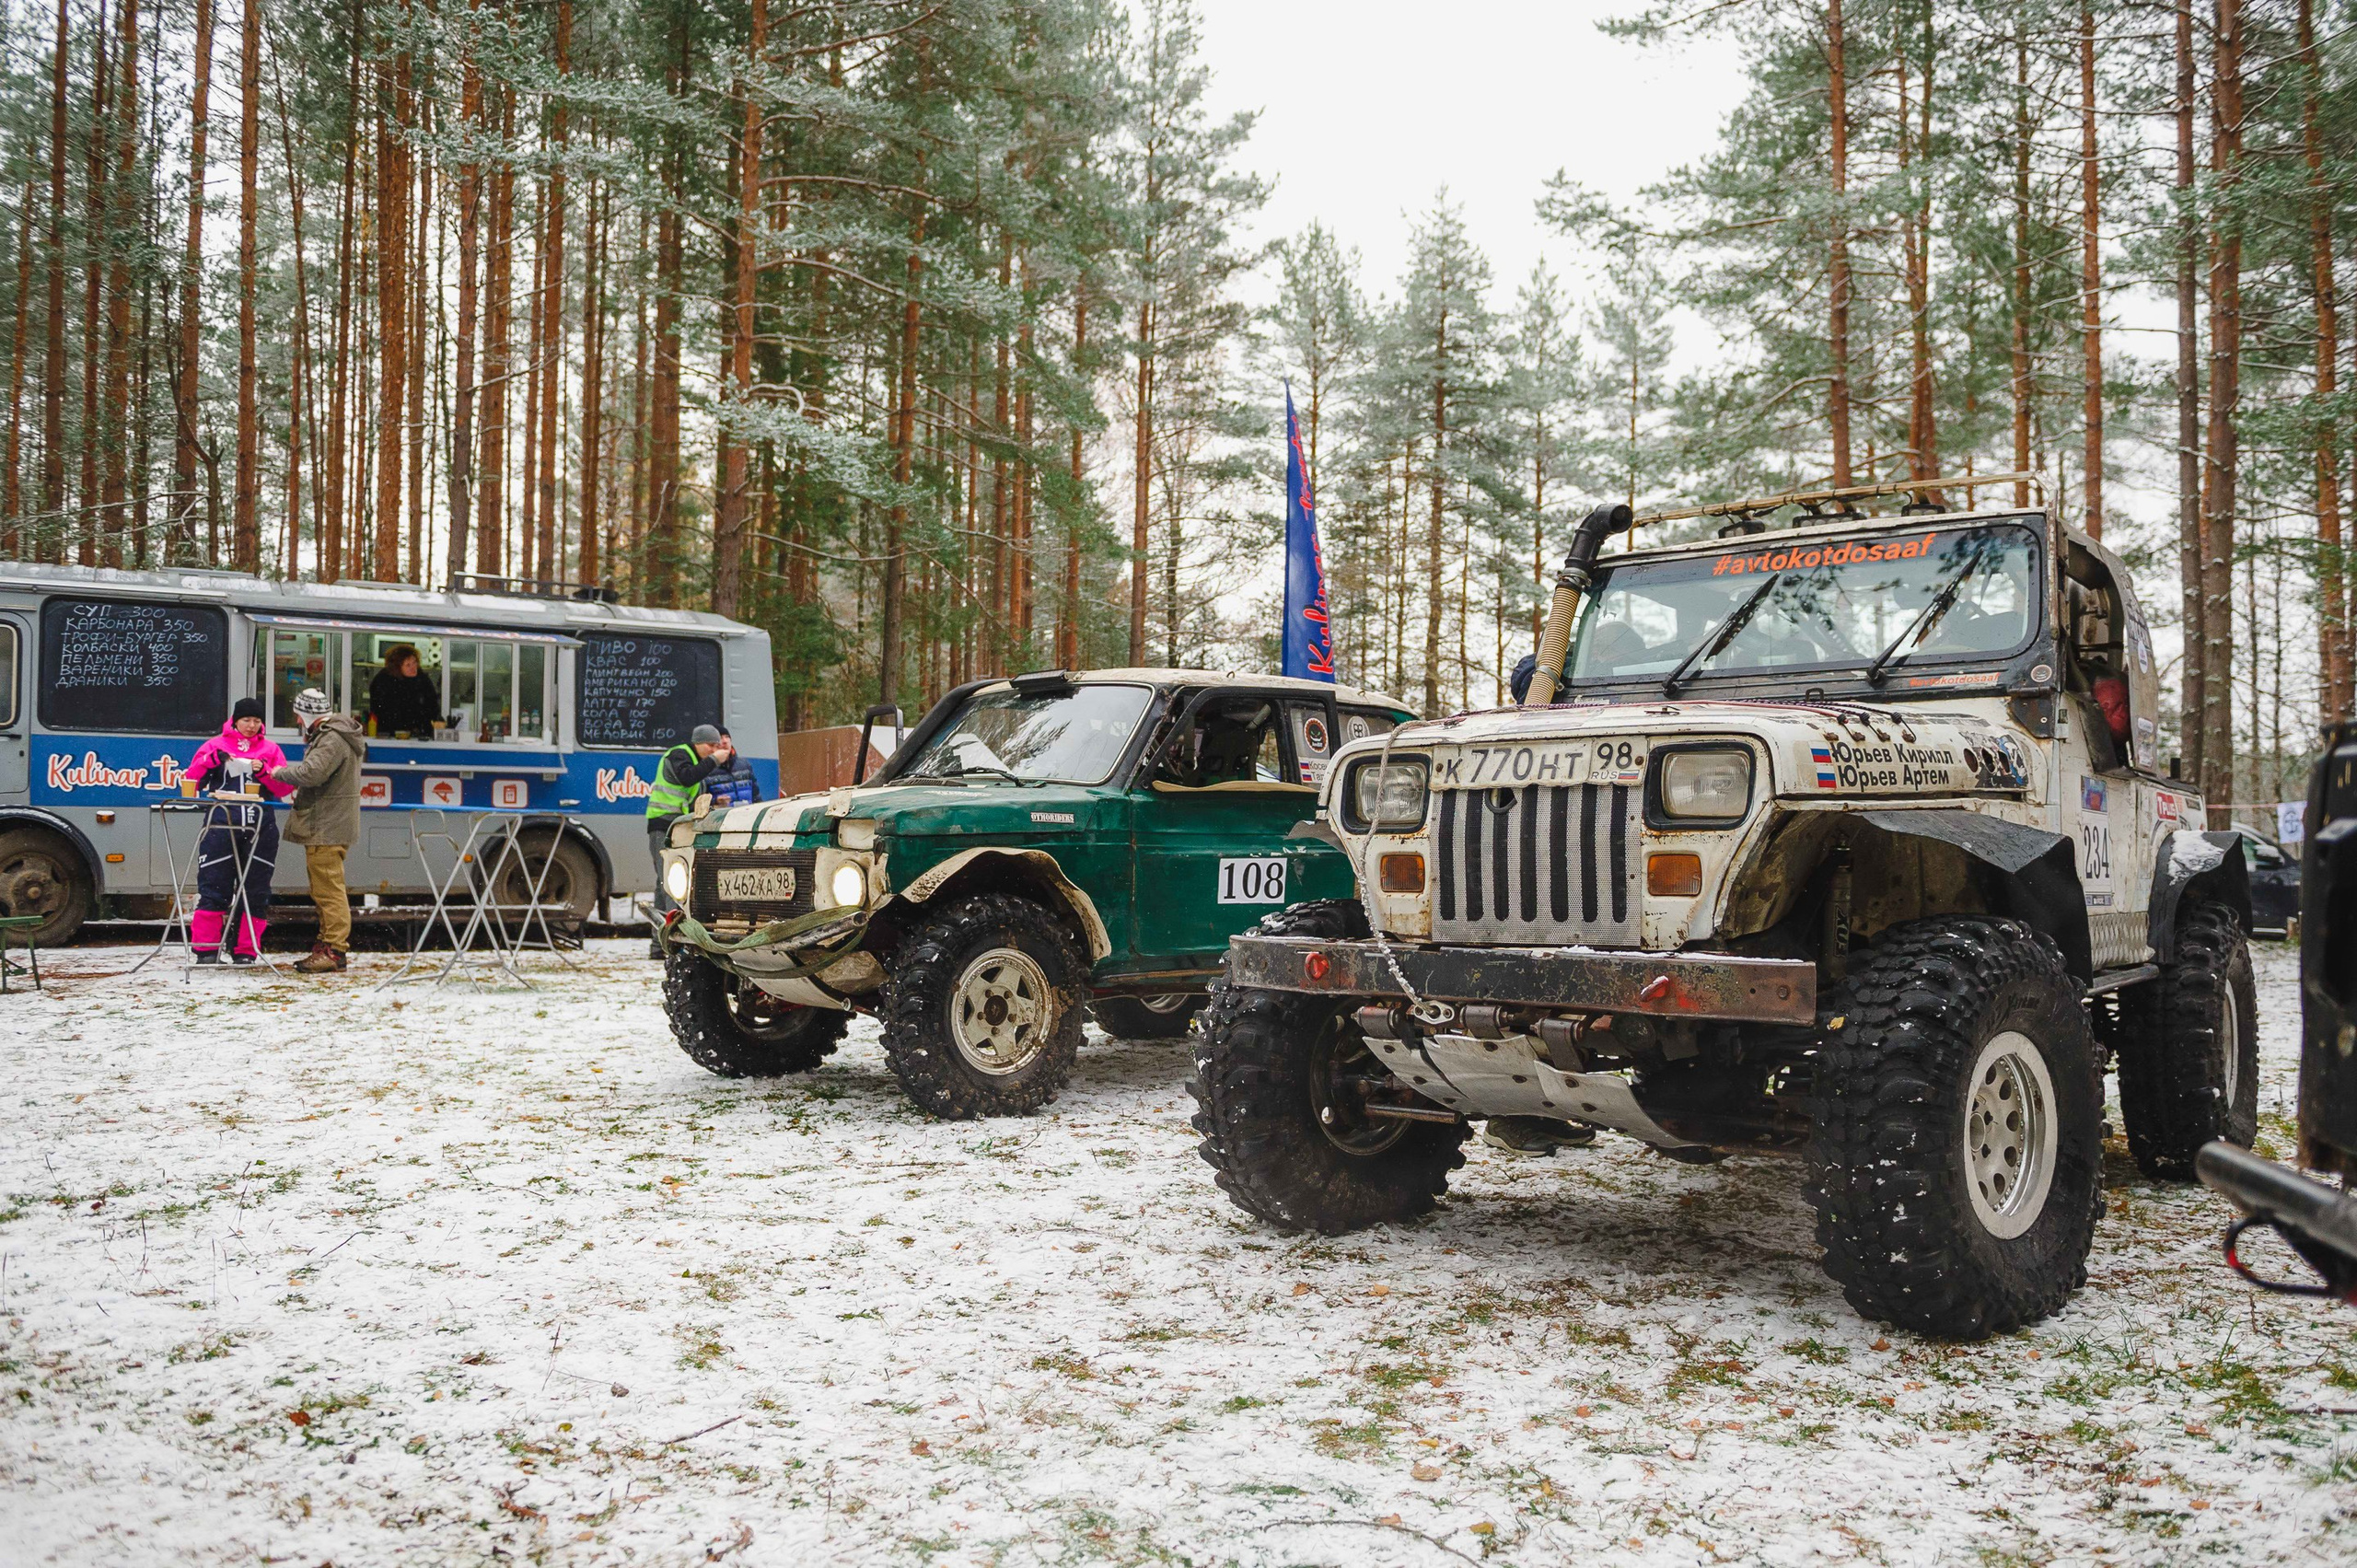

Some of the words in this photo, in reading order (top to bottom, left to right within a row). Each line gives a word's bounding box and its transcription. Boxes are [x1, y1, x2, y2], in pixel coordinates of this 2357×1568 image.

[1713, 532, 1937, 576] #avtokotdosaaf
[74, 605, 111, 617] СУП
[130, 606, 166, 619] 300
[65, 618, 154, 632] КАРБОНАРА
[163, 619, 194, 632] 350
[61, 632, 178, 645] ТРОФИ-БУРГЕР
[182, 633, 208, 643] 350
[62, 644, 140, 654] КОЛБАСКИ
[148, 644, 174, 653] 400
[587, 639, 636, 655] ПИВО
[648, 644, 672, 655] 100
[61, 654, 144, 665] ПЕЛЬМЕНИ
[151, 654, 178, 664] 350
[586, 655, 626, 668] КВАС
[641, 656, 661, 667] 100
[60, 665, 144, 676] ВАРЕНИКИ
[152, 665, 180, 676] 300
[55, 676, 129, 689] ДРАНИКИ
[144, 677, 172, 687] 350
[660, 678, 678, 688] 120
[584, 698, 626, 708] ЛАТТЕ
[629, 709, 649, 718] 100
[630, 719, 645, 729] 70
[653, 728, 676, 739] 150
[1596, 742, 1632, 769] 98
[1830, 741, 1892, 769] Юрьев
[1893, 743, 1954, 767] Кирилл
[1591, 771, 1618, 780] RUS
[1838, 764, 1897, 792] Юрьев
[1902, 764, 1949, 791] Артем
[597, 766, 656, 803] Kulin
[2084, 825, 2110, 879] 234
[776, 872, 790, 889] 98
[1224, 862, 1284, 899] 108
